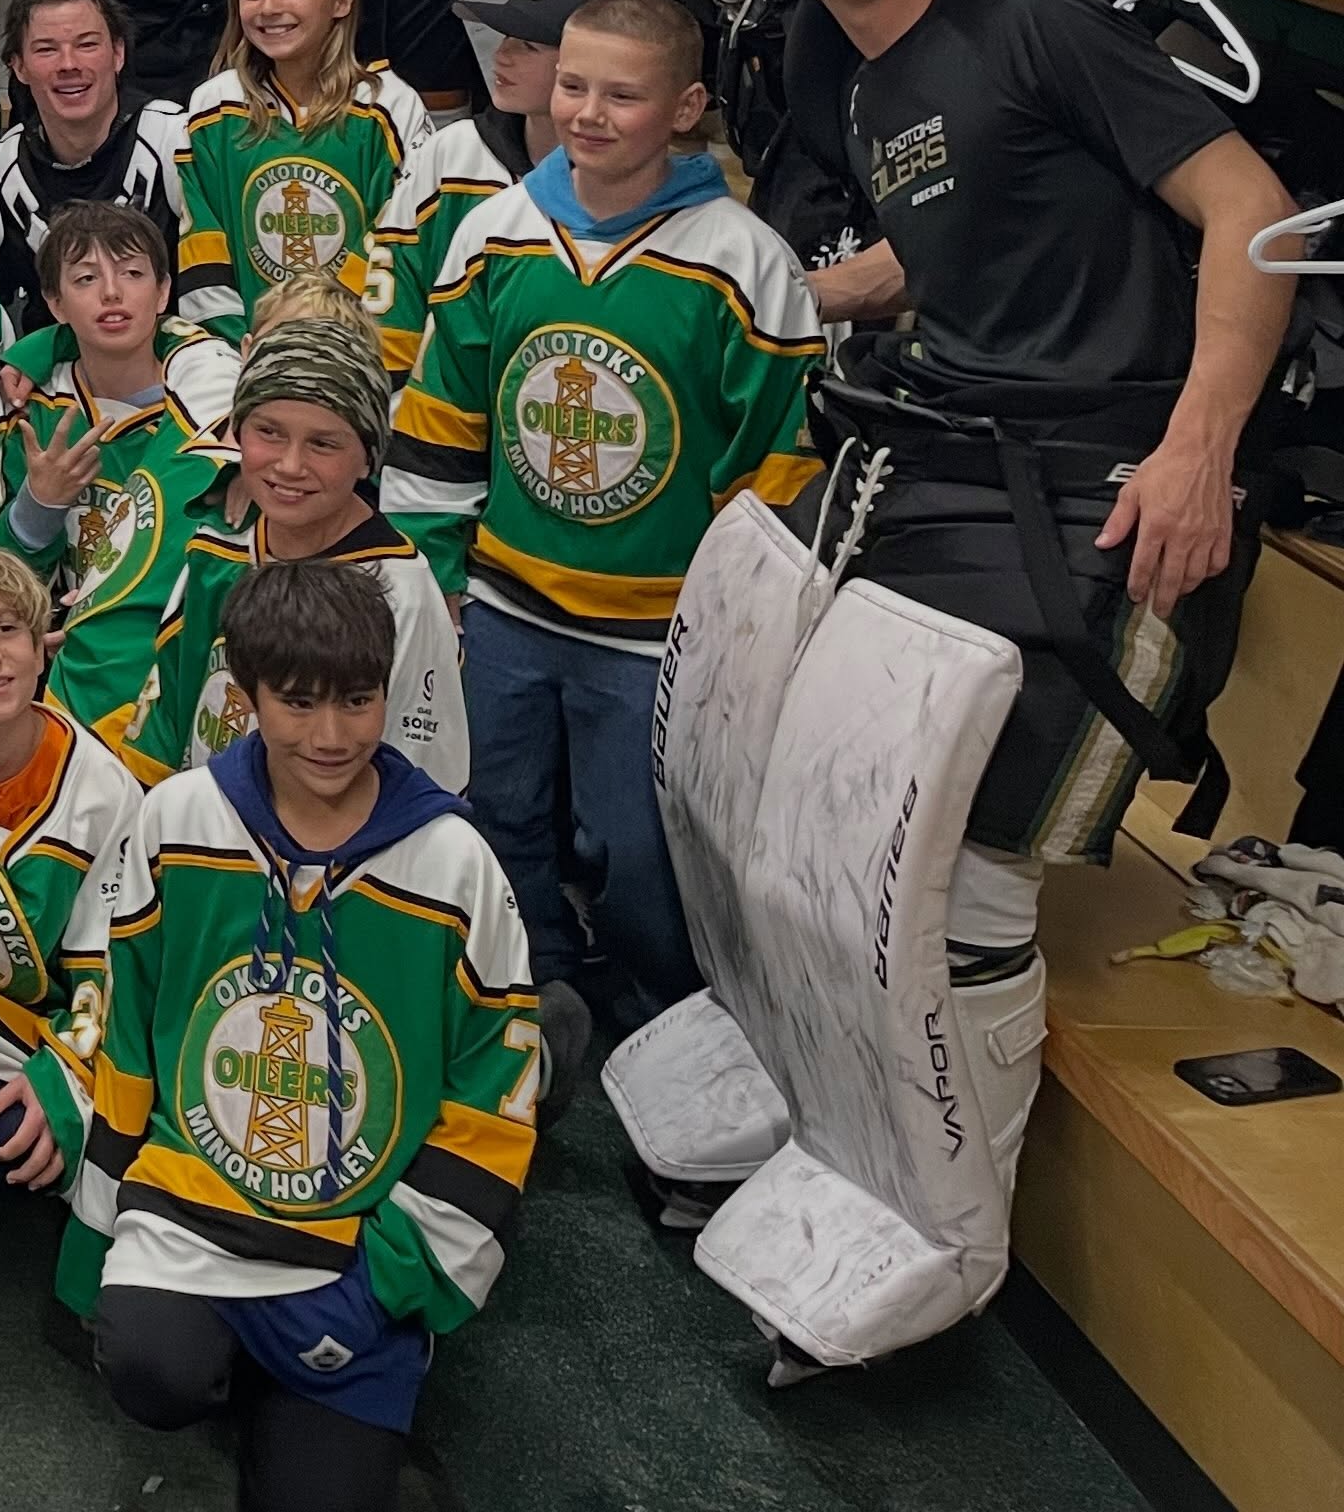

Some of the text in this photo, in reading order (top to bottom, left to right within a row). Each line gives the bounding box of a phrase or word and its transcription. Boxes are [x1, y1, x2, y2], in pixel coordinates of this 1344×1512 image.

[255, 164, 342, 195] OKOTOKS
[260, 211, 340, 236] OILERS
[521, 333, 647, 385] OKOTOKS
[522, 399, 639, 446] OILERS
[509, 443, 657, 517] MINOR HOCKEY
[652, 612, 689, 791] BAUER
[873, 775, 918, 989] BAUER
[215, 962, 372, 1033] OKOTOKS
[213, 1046, 358, 1111] OILERS
[920, 997, 967, 1161] VAPOR
[184, 1104, 376, 1201] MINOR HOCKEY
